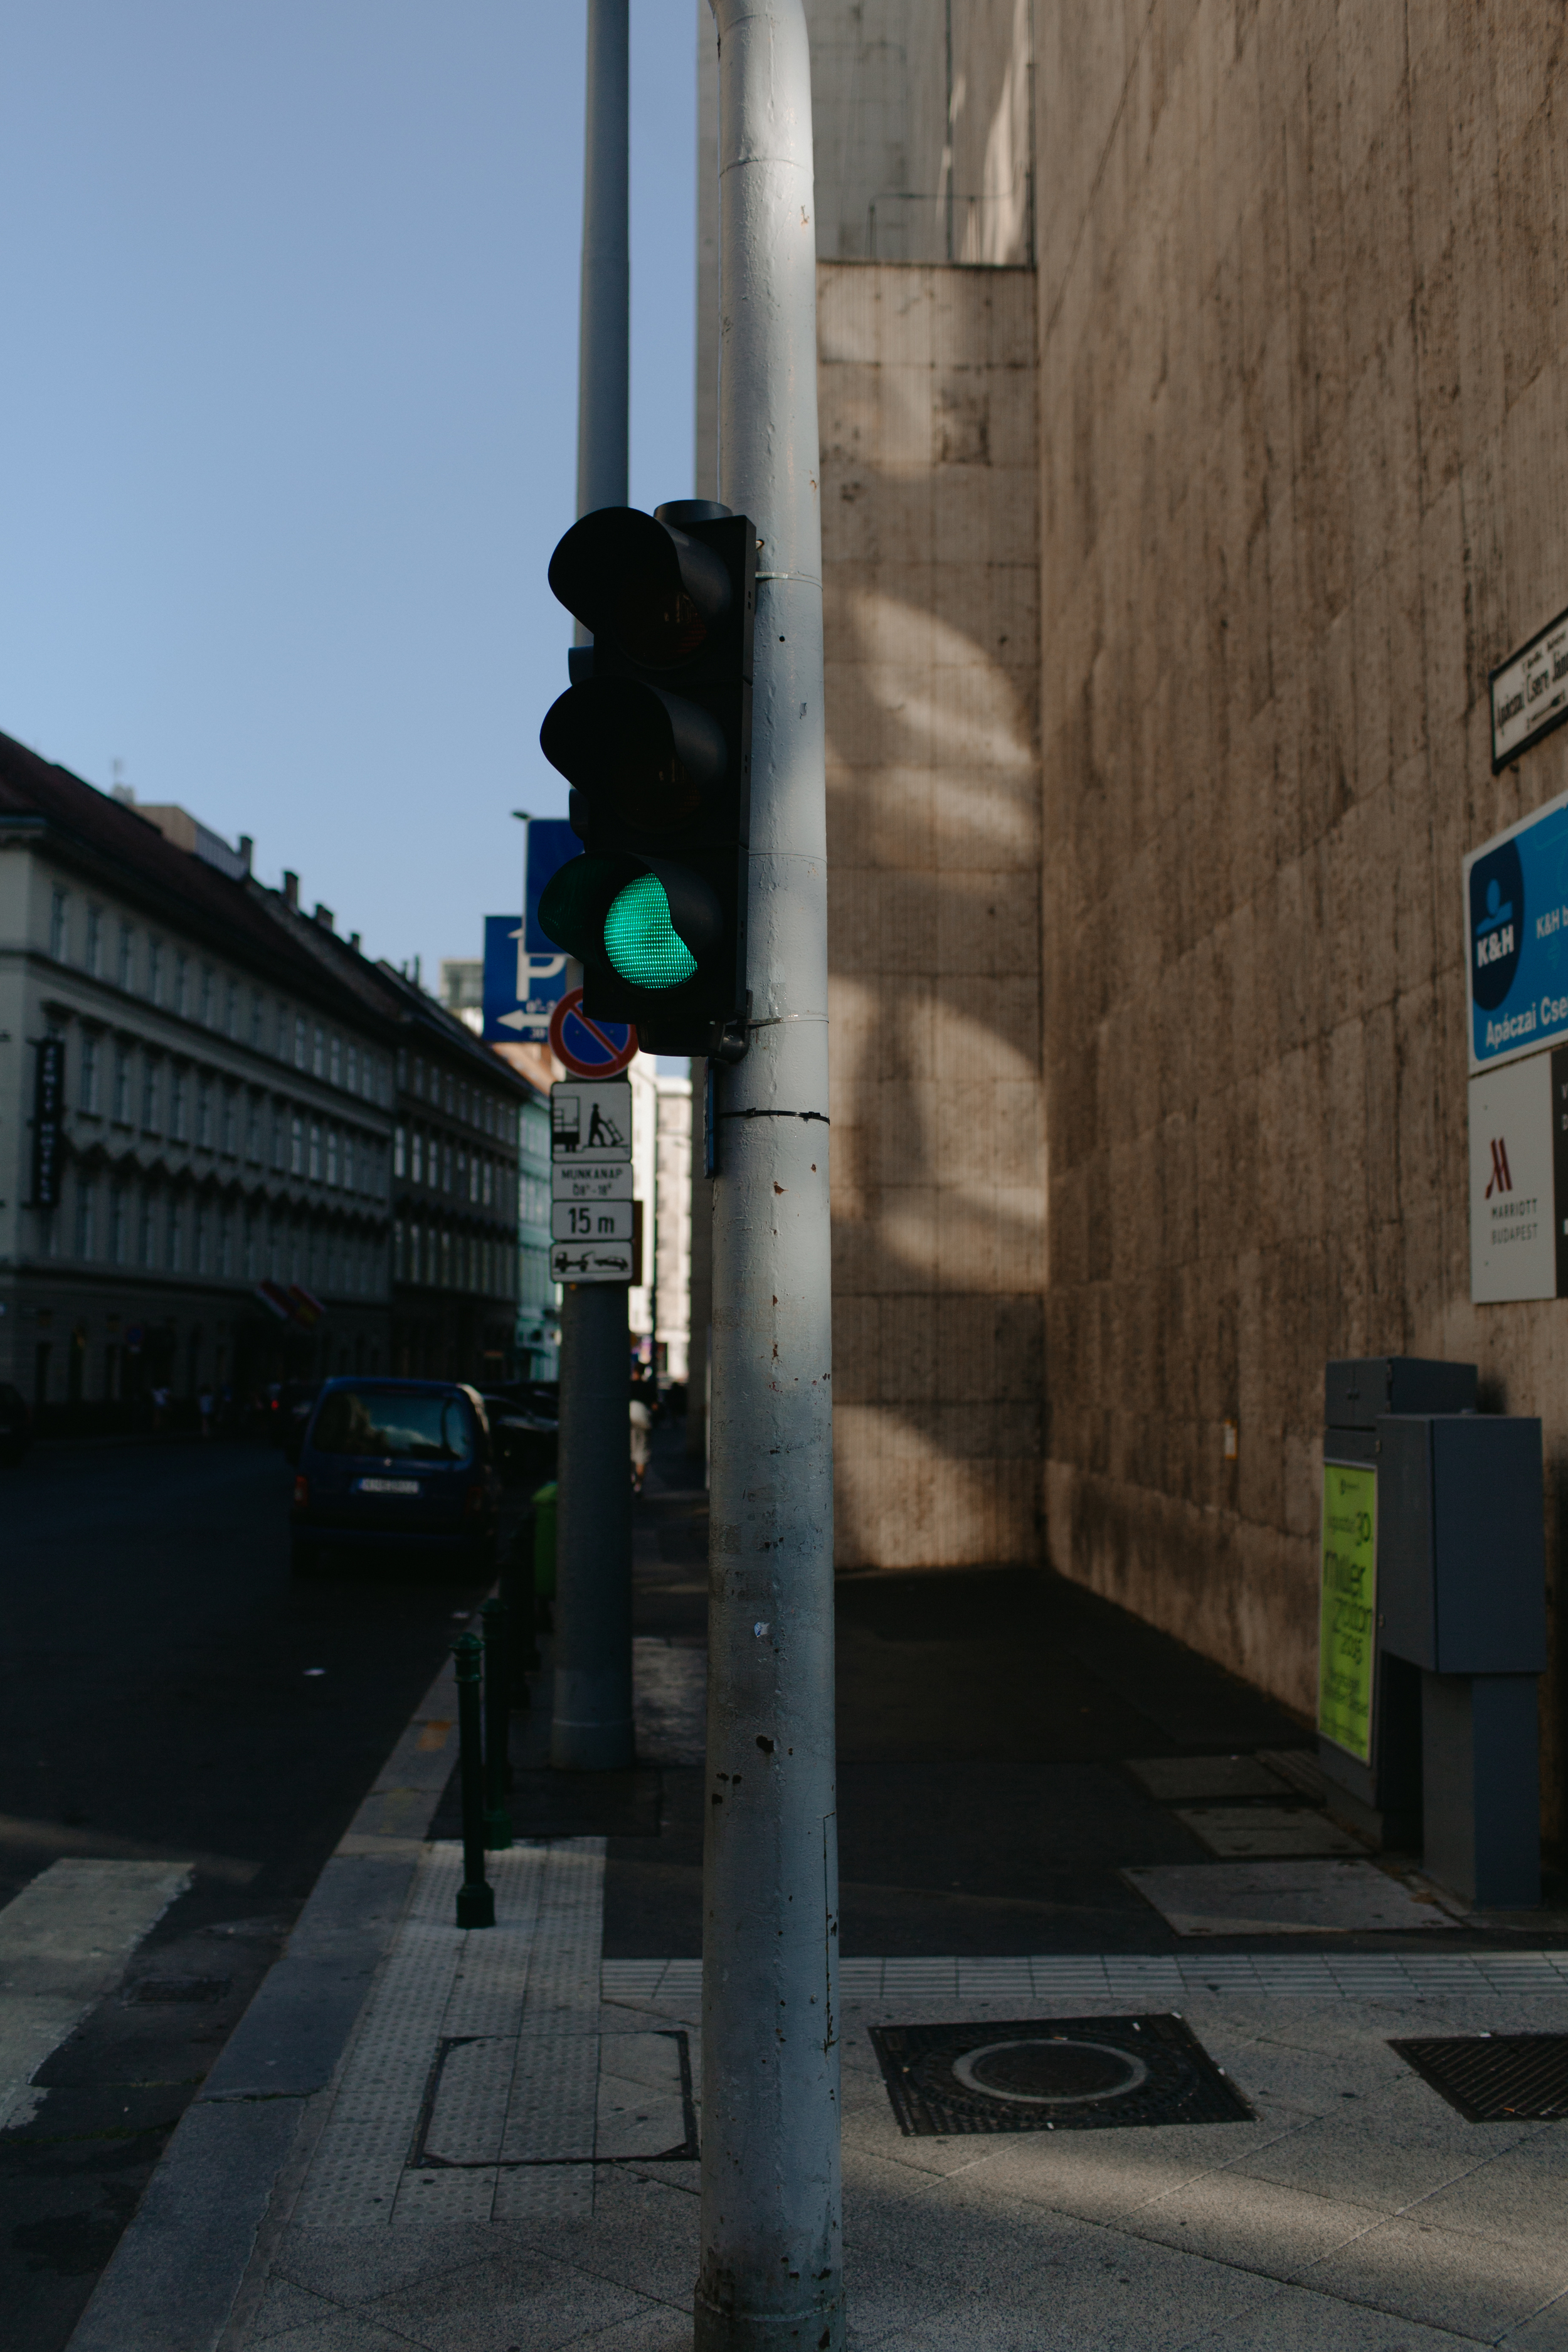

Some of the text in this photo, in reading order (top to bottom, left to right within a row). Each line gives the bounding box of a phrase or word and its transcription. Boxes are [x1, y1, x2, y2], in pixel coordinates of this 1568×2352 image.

[1536, 908, 1560, 940] K&H
[1476, 924, 1515, 968] K&H
[1486, 996, 1568, 1051] Apáczai Cse
[561, 1168, 623, 1179] MUNKANAP
[568, 1207, 615, 1234] 15 m
[1491, 1199, 1538, 1219] MARRIOTT
[1491, 1223, 1538, 1245] BUDAPEST
